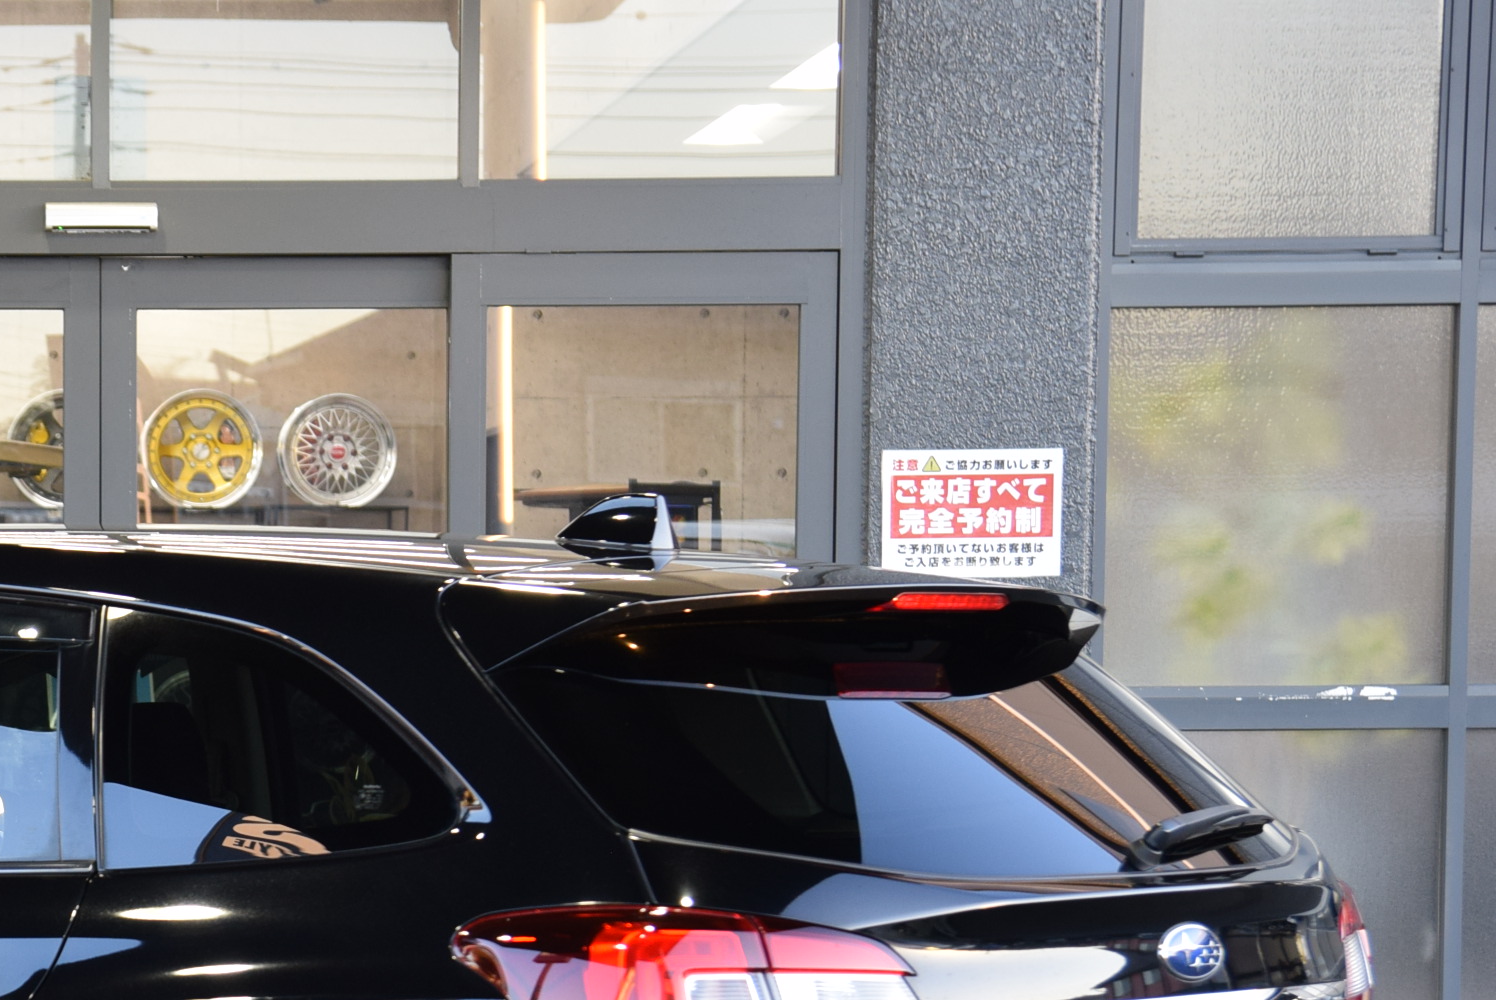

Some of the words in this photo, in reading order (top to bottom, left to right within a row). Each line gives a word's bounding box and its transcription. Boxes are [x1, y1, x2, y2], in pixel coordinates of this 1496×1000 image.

[892, 459, 919, 471] 注意
[945, 458, 1053, 471] ご協力お願いします
[895, 477, 1047, 505] ご来店すべて
[898, 507, 1042, 535] 完全予約制
[897, 542, 1044, 555] ご予約頂いてないお客様は
[904, 556, 1037, 568] ご入店をお断り致します
